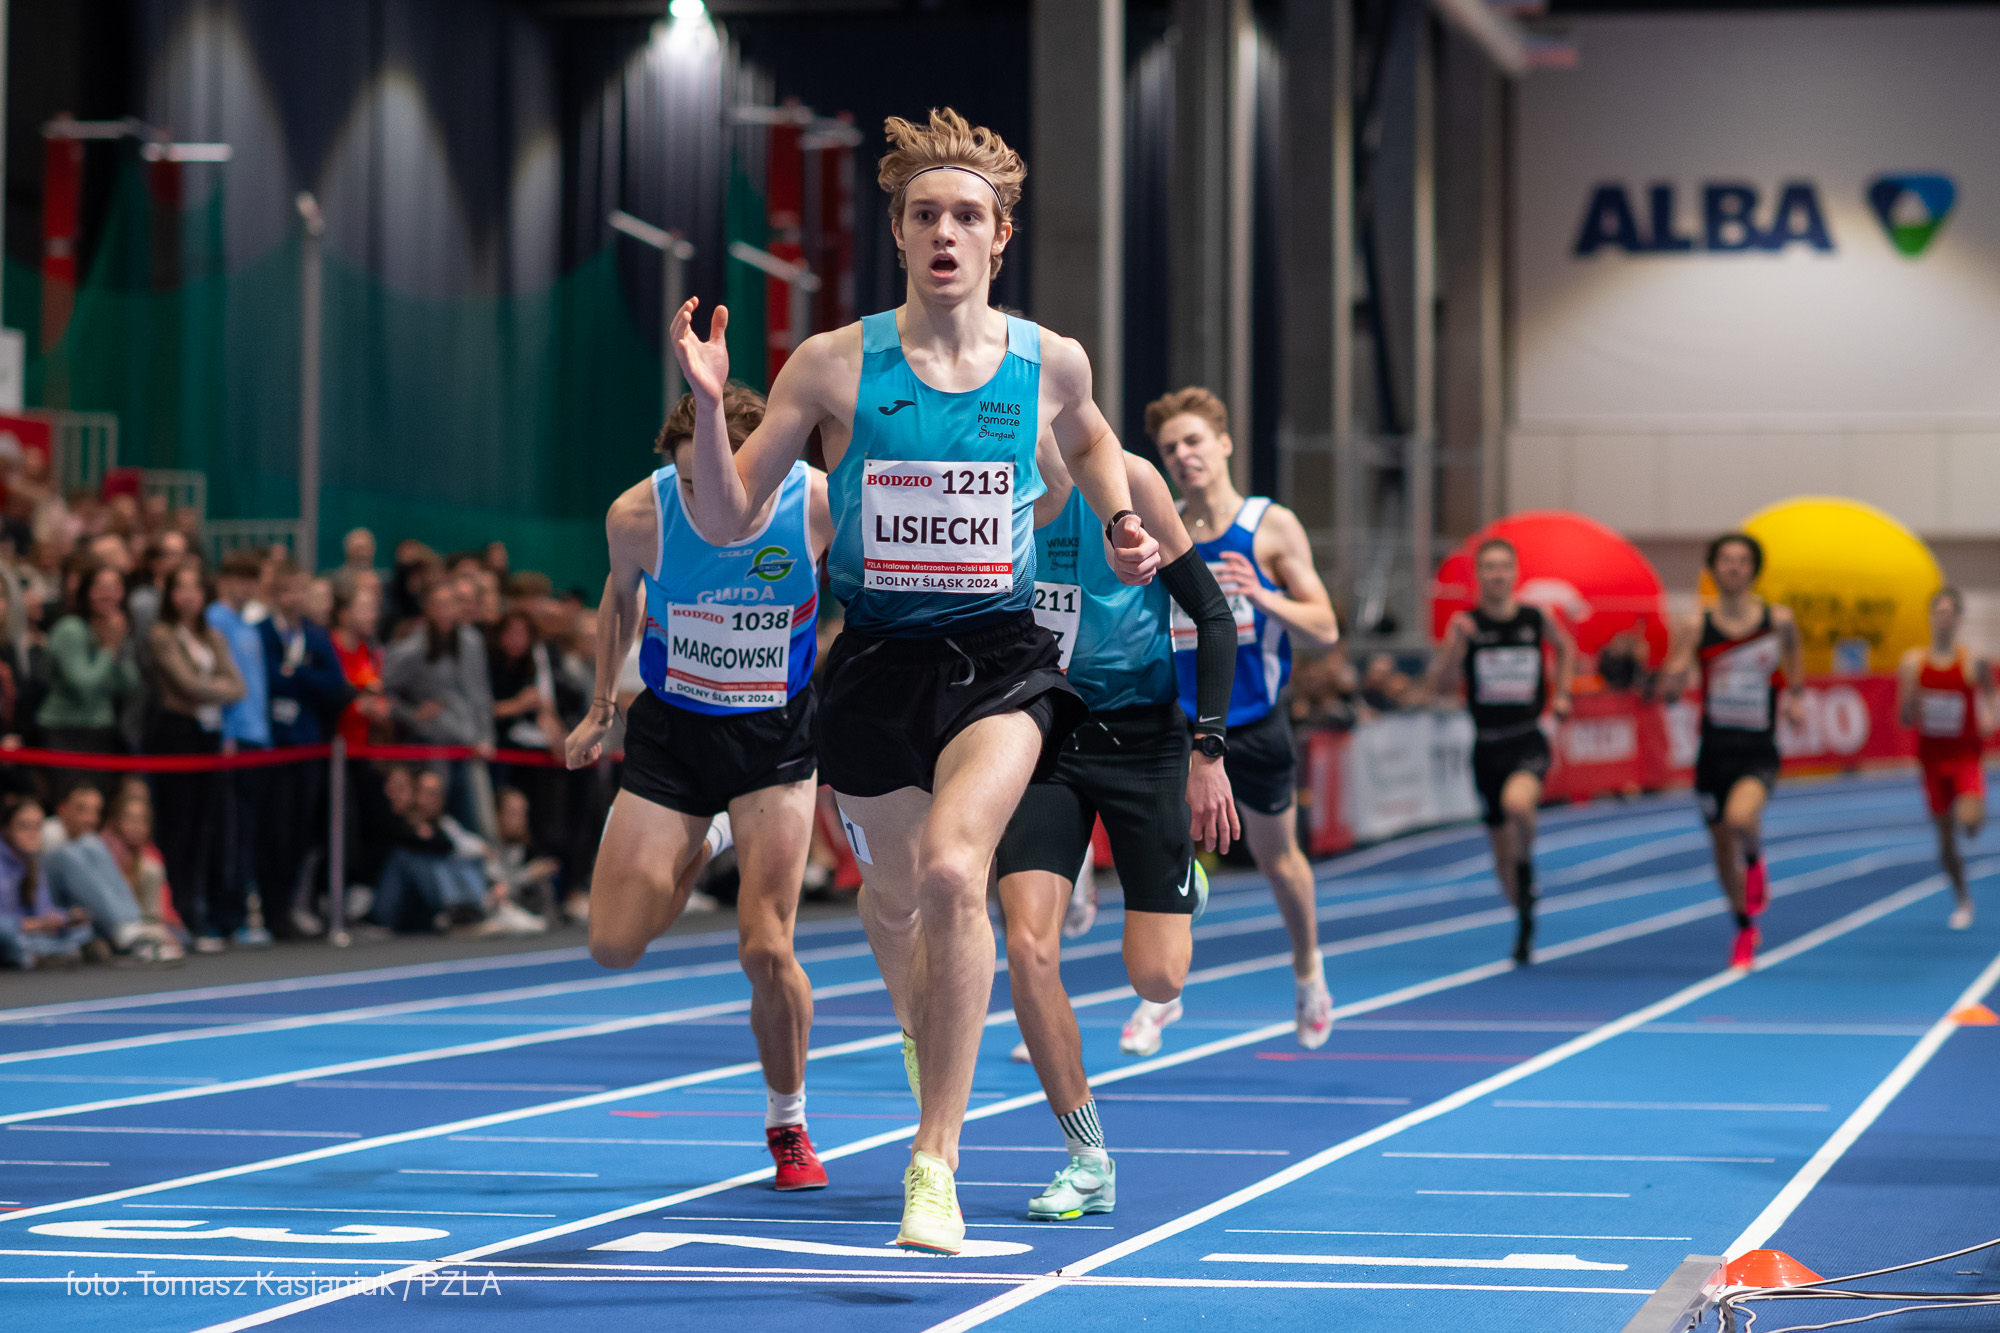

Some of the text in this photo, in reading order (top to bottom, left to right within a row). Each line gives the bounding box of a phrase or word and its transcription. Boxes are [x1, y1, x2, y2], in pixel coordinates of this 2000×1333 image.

[1574, 180, 1838, 256] ALBA
[979, 401, 1020, 415] WMLKS
[978, 414, 1020, 426] Pomorze
[979, 425, 1015, 441] Stargard
[867, 474, 932, 487] BODZIO
[941, 470, 1009, 495] 1213
[876, 515, 998, 545] LISIECKI
[883, 562, 910, 570] Halowe
[911, 563, 955, 572] Mistrzostwa
[876, 575, 999, 590] DOLNY ŚLĄSK 2024
[697, 585, 775, 605] GWDA
[1034, 588, 1076, 613] 211
[672, 609, 725, 625] BODZIO
[732, 611, 789, 631] 1038
[673, 635, 784, 670] MARGOWSKI
[677, 683, 775, 704] DOLNY ŚLĄSK 2024
[846, 822, 860, 856] 1
[28, 1220, 450, 1243] 3
[587, 1232, 1034, 1258] 2
